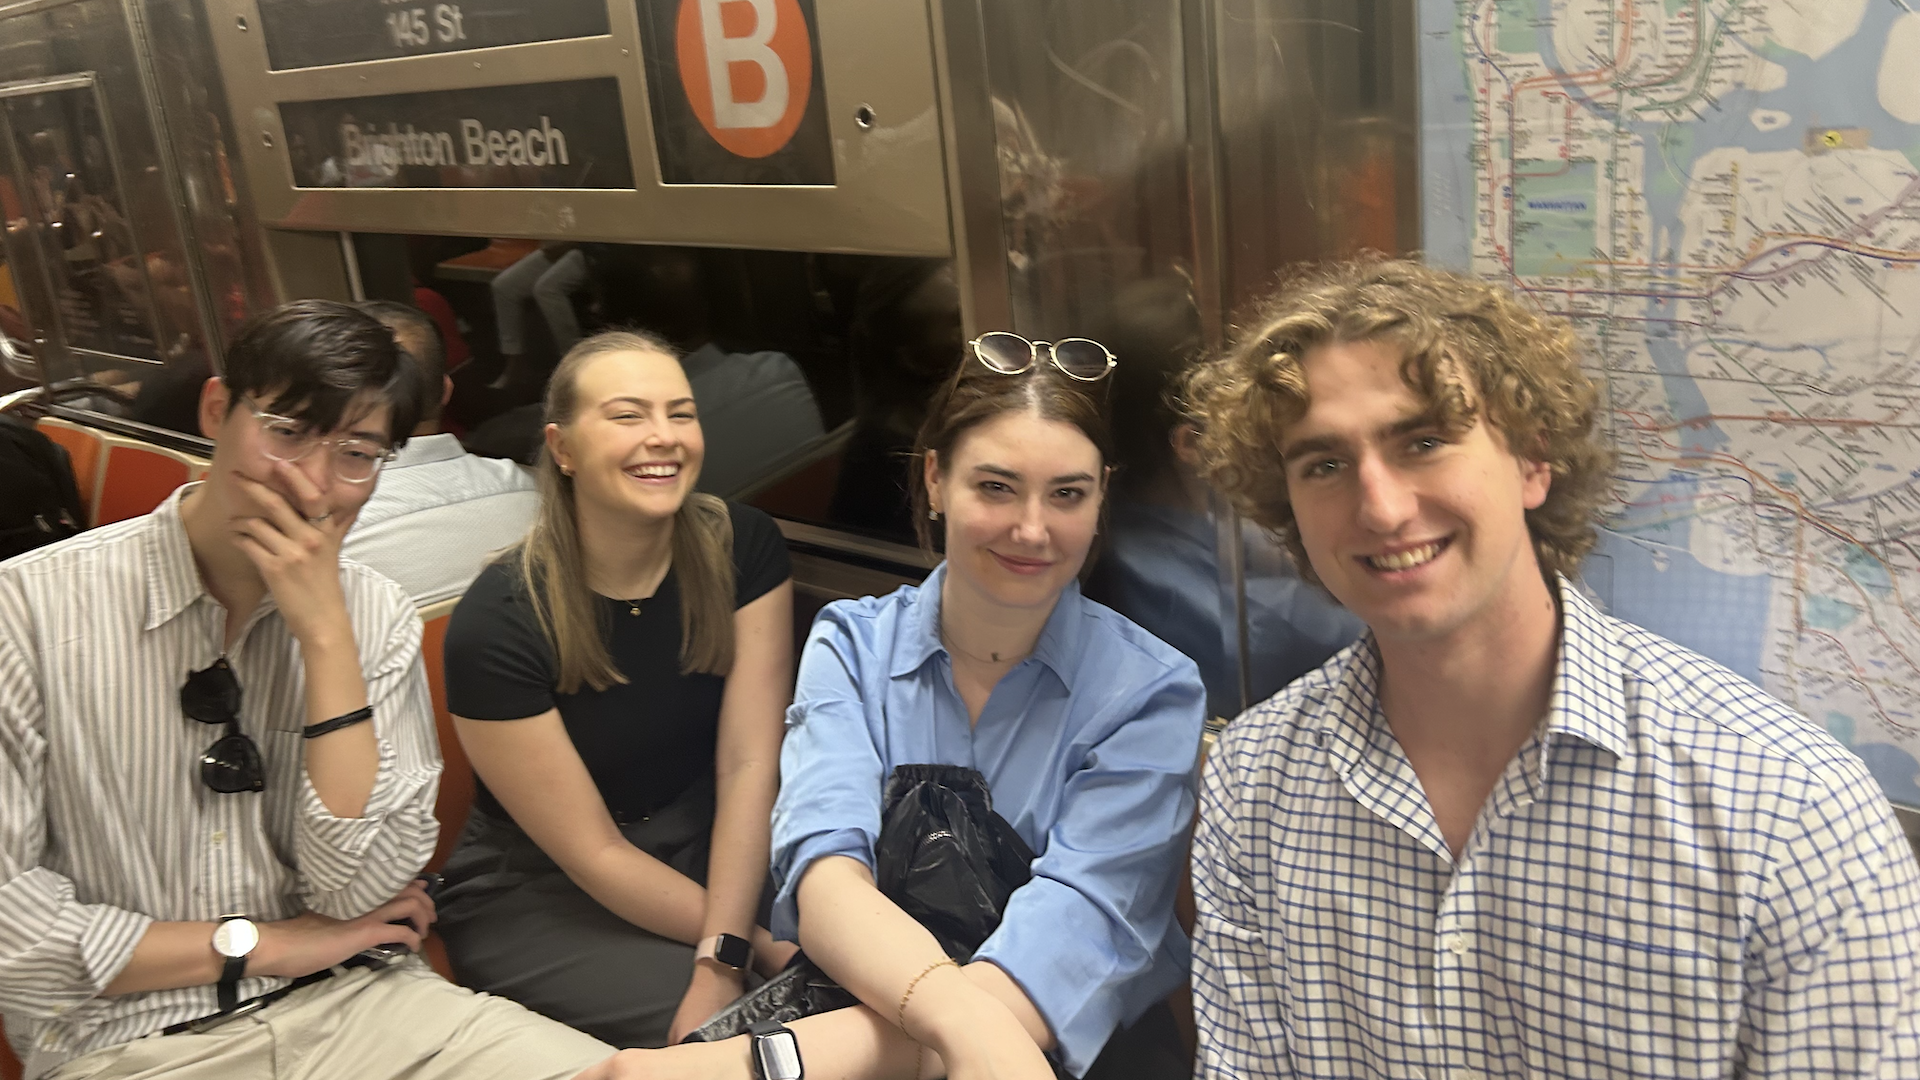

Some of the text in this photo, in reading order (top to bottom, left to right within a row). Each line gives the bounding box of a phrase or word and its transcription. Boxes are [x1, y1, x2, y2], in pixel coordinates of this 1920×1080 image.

[386, 3, 467, 47] 145 St
[698, 0, 789, 129] B
[342, 115, 569, 177] Brighton Beach
